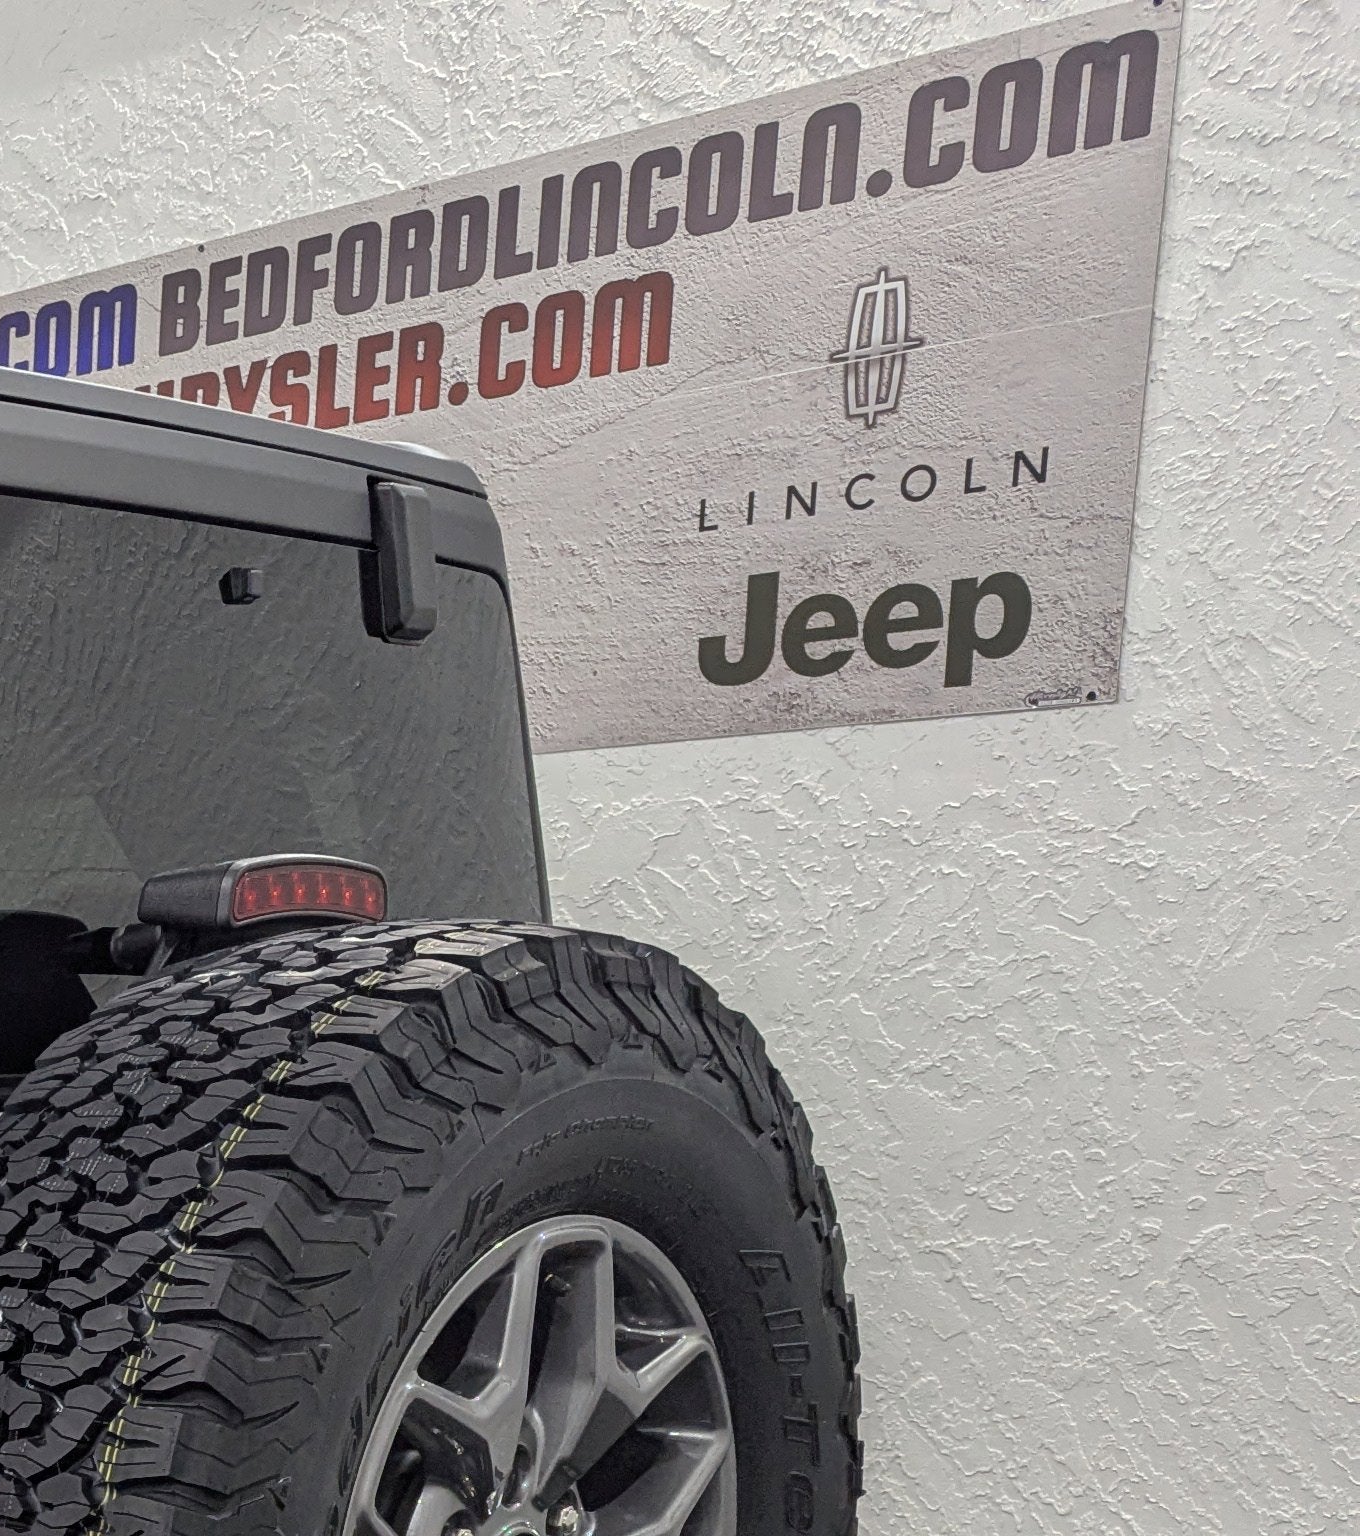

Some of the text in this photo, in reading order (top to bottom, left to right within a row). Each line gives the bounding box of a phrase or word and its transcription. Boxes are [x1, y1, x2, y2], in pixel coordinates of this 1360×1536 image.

[158, 28, 1158, 357] BEDFORDLINCOLN.COM
[136, 269, 676, 431] YSLER.COM
[698, 446, 1050, 533] LINCOLN
[697, 571, 1033, 688] Jeep
